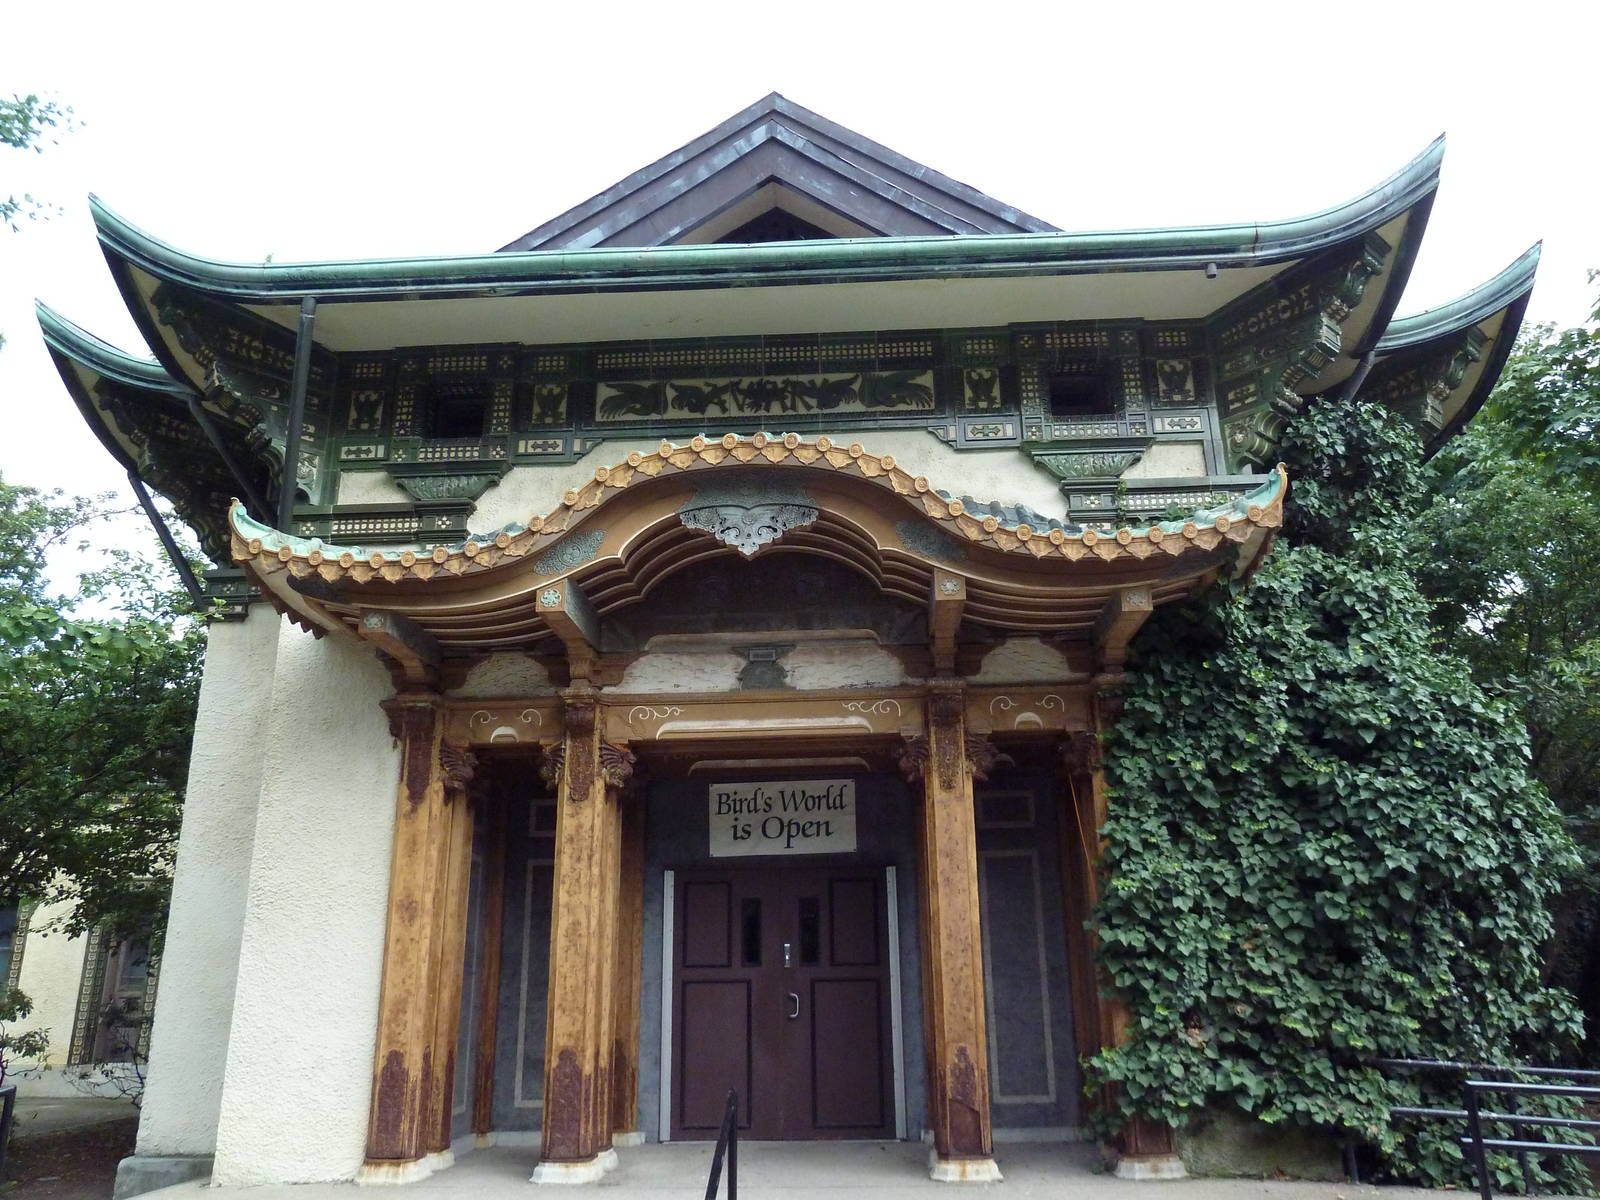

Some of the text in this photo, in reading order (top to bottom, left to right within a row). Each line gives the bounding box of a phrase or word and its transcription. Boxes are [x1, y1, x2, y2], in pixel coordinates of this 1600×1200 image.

[716, 785, 847, 815] Bird's World
[731, 816, 834, 849] is Open
